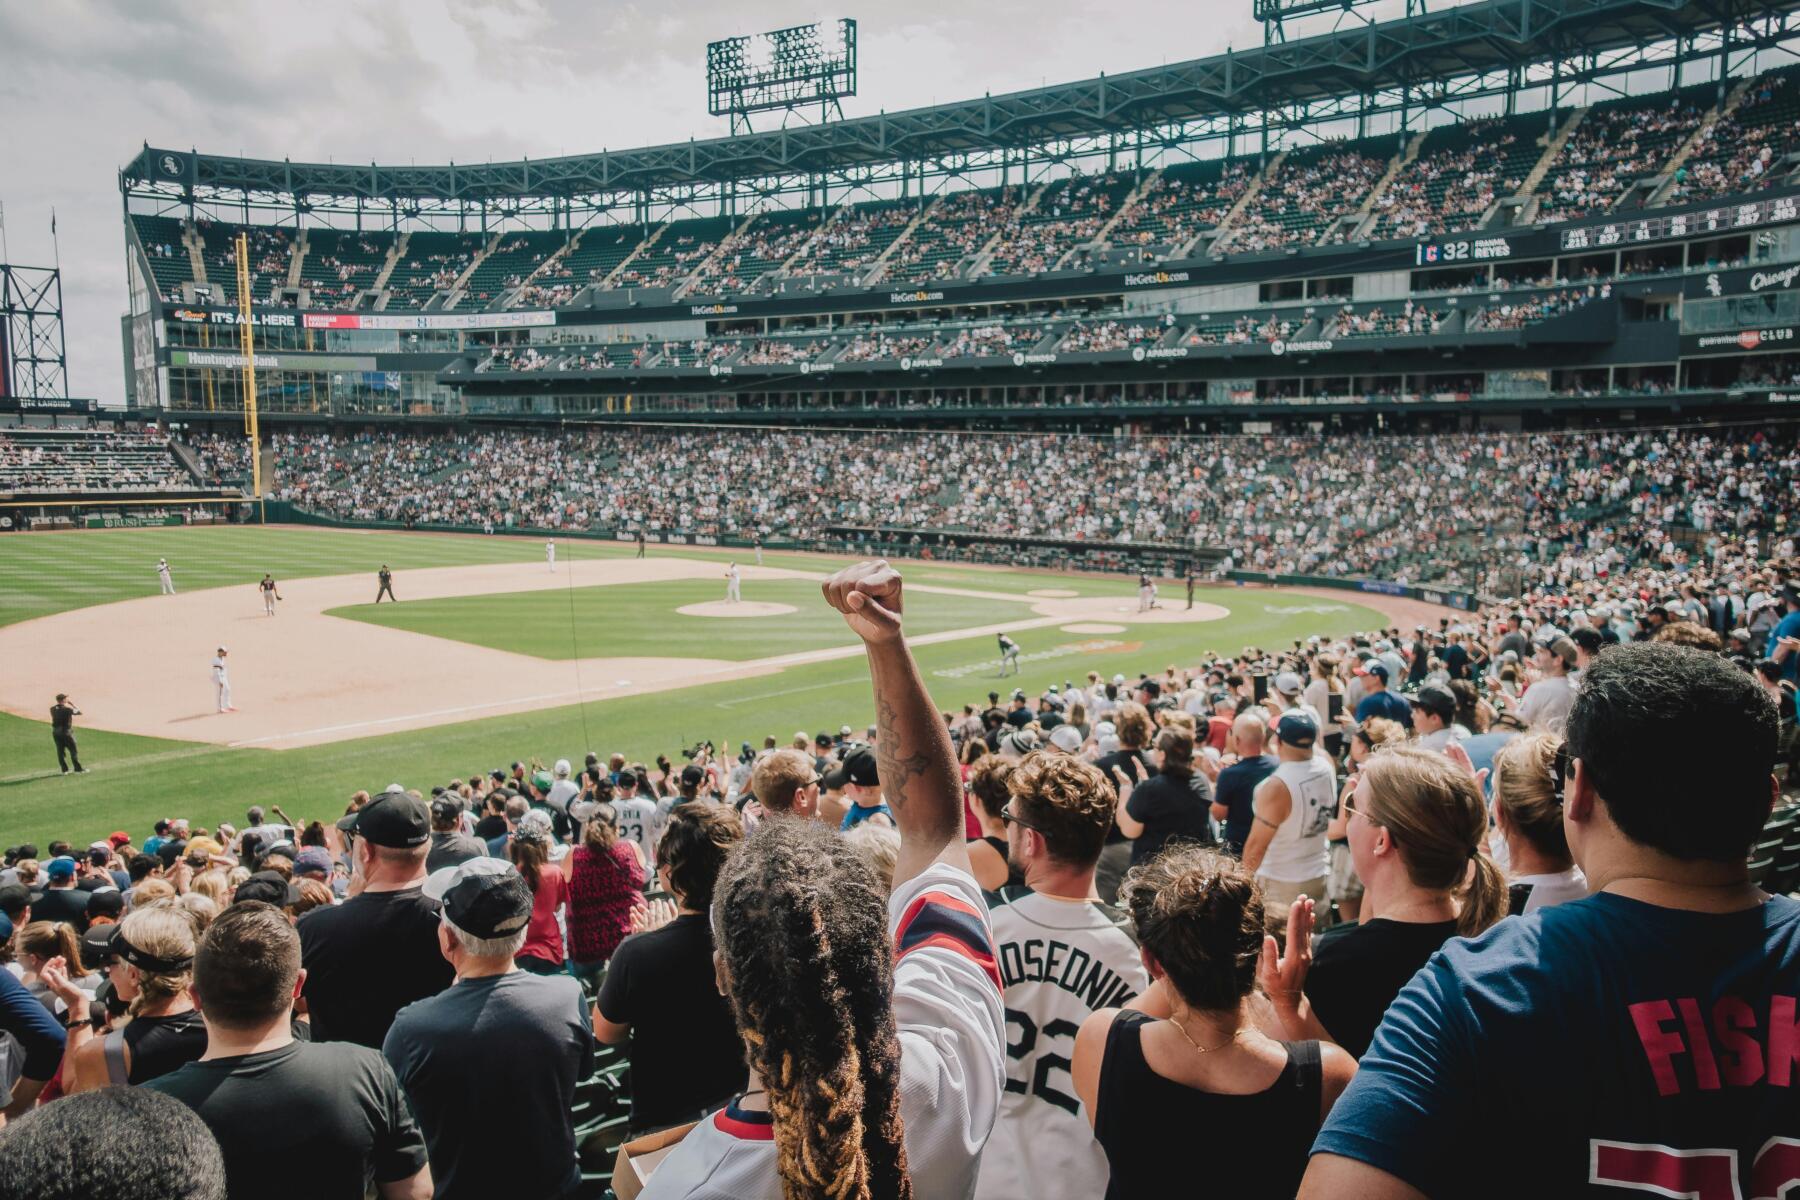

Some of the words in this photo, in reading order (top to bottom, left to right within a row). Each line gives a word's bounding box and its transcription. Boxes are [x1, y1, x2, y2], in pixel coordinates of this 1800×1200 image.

[1443, 241, 1470, 260] 32
[1474, 245, 1511, 259] REYES
[1124, 272, 1189, 286] HeGetsUs.com
[890, 291, 944, 303] HeGetsUs.com
[691, 304, 738, 315] HeGetsUs.com
[211, 311, 234, 324] IT'S
[262, 314, 296, 327] HERE
[1760, 328, 1794, 341] CLUB
[188, 352, 249, 368] Huntington
[252, 355, 278, 367] Bank
[114, 518, 142, 528] RUSH
[998, 938, 1138, 1012] DSEDNIK
